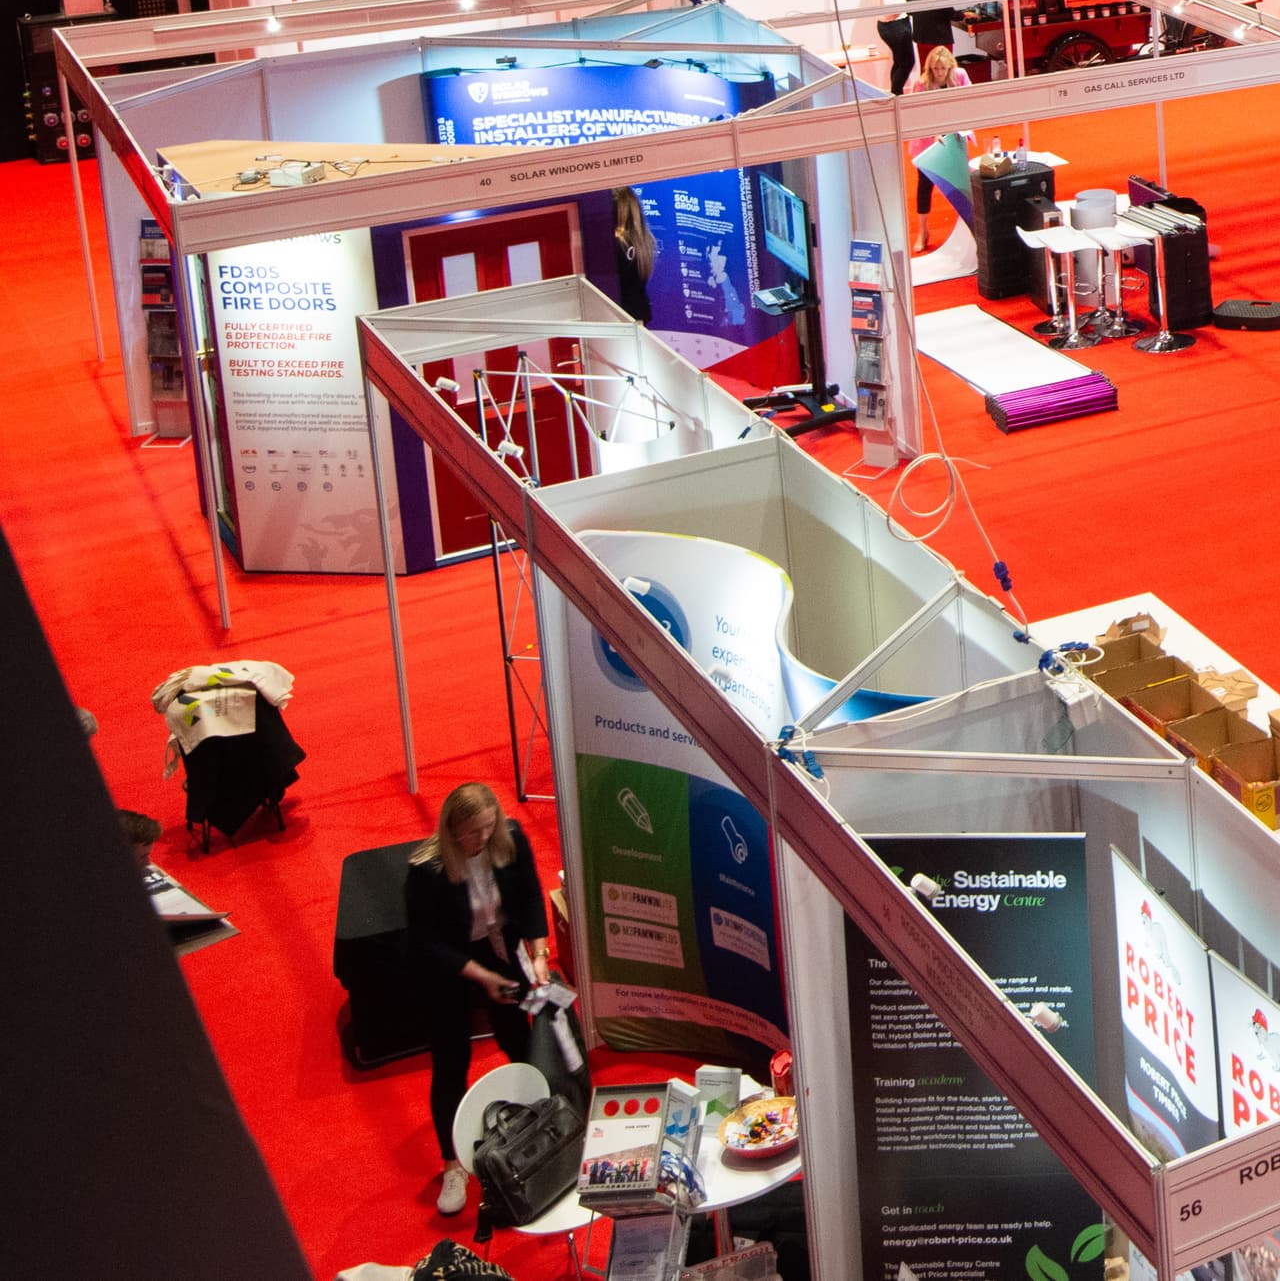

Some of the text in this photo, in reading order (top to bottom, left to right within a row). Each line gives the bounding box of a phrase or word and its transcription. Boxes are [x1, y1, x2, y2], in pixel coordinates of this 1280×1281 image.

[1084, 85, 1102, 94] GAS
[1104, 82, 1126, 91] CALL
[1128, 75, 1168, 87] SERVICES
[1169, 72, 1185, 81] LTD
[473, 108, 699, 132] SPECIALIST MANUFACTURERS
[474, 123, 606, 145] INSTALLERS OF
[479, 154, 644, 187] 40 SOLAR WINDOWS LIMITED
[674, 194, 698, 205] SOLAR
[674, 202, 700, 212] GROUP
[219, 265, 280, 280] FD30S
[220, 281, 333, 296] COMPOSITE
[222, 296, 337, 311] FIRE DOORS
[224, 322, 314, 332] FULLY CERTIFIED
[235, 332, 309, 342] DEPENDABLE
[309, 332, 333, 342] FIRE
[228, 359, 345, 370] BUILT TO EXCEED FIRE
[230, 368, 345, 380] TESTING STANDARDS.
[595, 714, 647, 736] Products
[649, 723, 671, 741] and
[612, 845, 663, 863] Development
[953, 870, 1067, 889] Sustainable
[932, 891, 1046, 912] Energy Centre
[868, 959, 888, 968] The
[1008, 977, 1028, 986] range
[1126, 941, 1195, 1038] ROBERT
[1127, 976, 1197, 1085] PRICE
[874, 1074, 964, 1088] Training academy
[881, 1203, 945, 1216] Get in touch
[1179, 1199, 1203, 1222] 56
[899, 1223, 936, 1232] dedicated
[938, 1223, 964, 1232] energy
[1001, 1222, 1022, 1231] ready
[1034, 1220, 1053, 1230] help.
[883, 1235, 1013, 1248] energy@robert-price.co.uk
[947, 1260, 1000, 1270] Energy Centre
[950, 1270, 985, 1279] specialist
